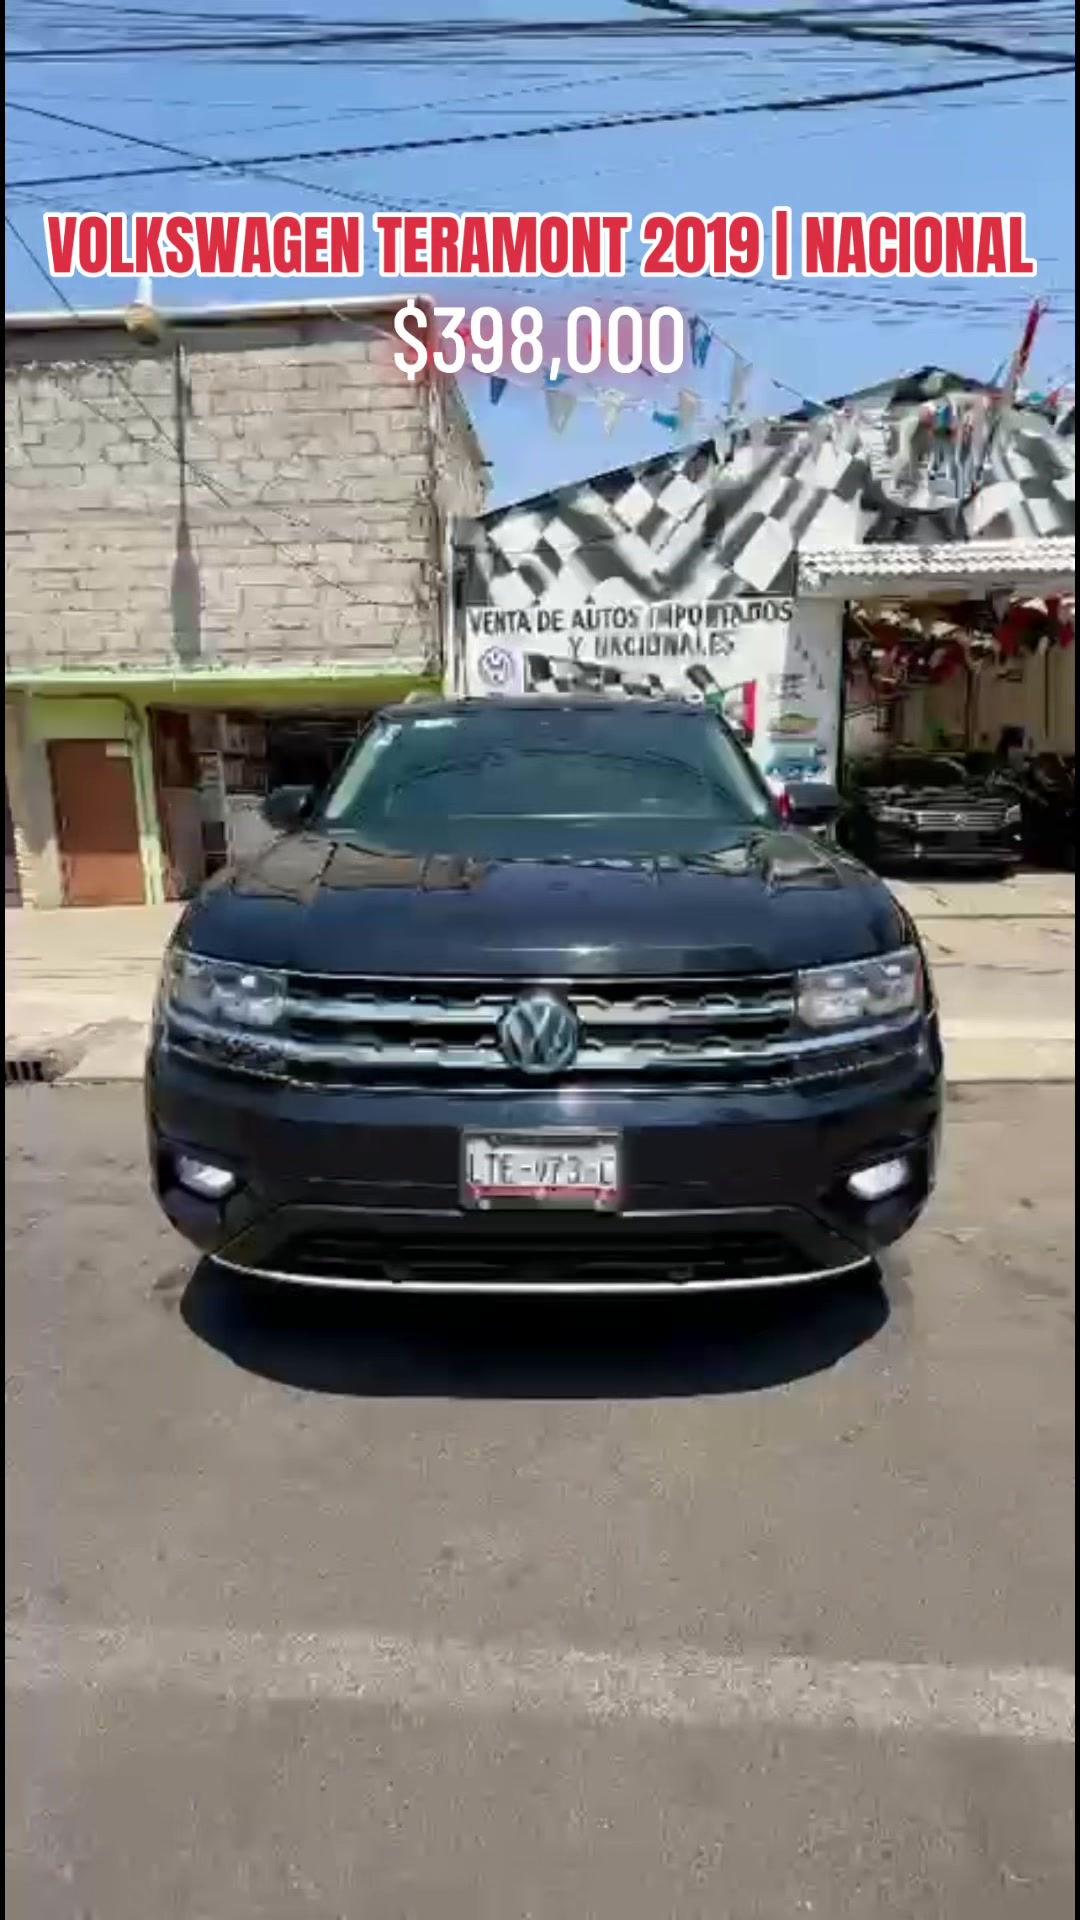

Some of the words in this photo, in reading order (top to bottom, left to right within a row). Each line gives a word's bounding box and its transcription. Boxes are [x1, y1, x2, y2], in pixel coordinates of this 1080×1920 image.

[468, 610, 532, 635] VENTA
[537, 609, 565, 633] DE
[571, 606, 640, 632] AUTOS
[567, 636, 584, 660] Y
[594, 631, 735, 657] NACIONALES
